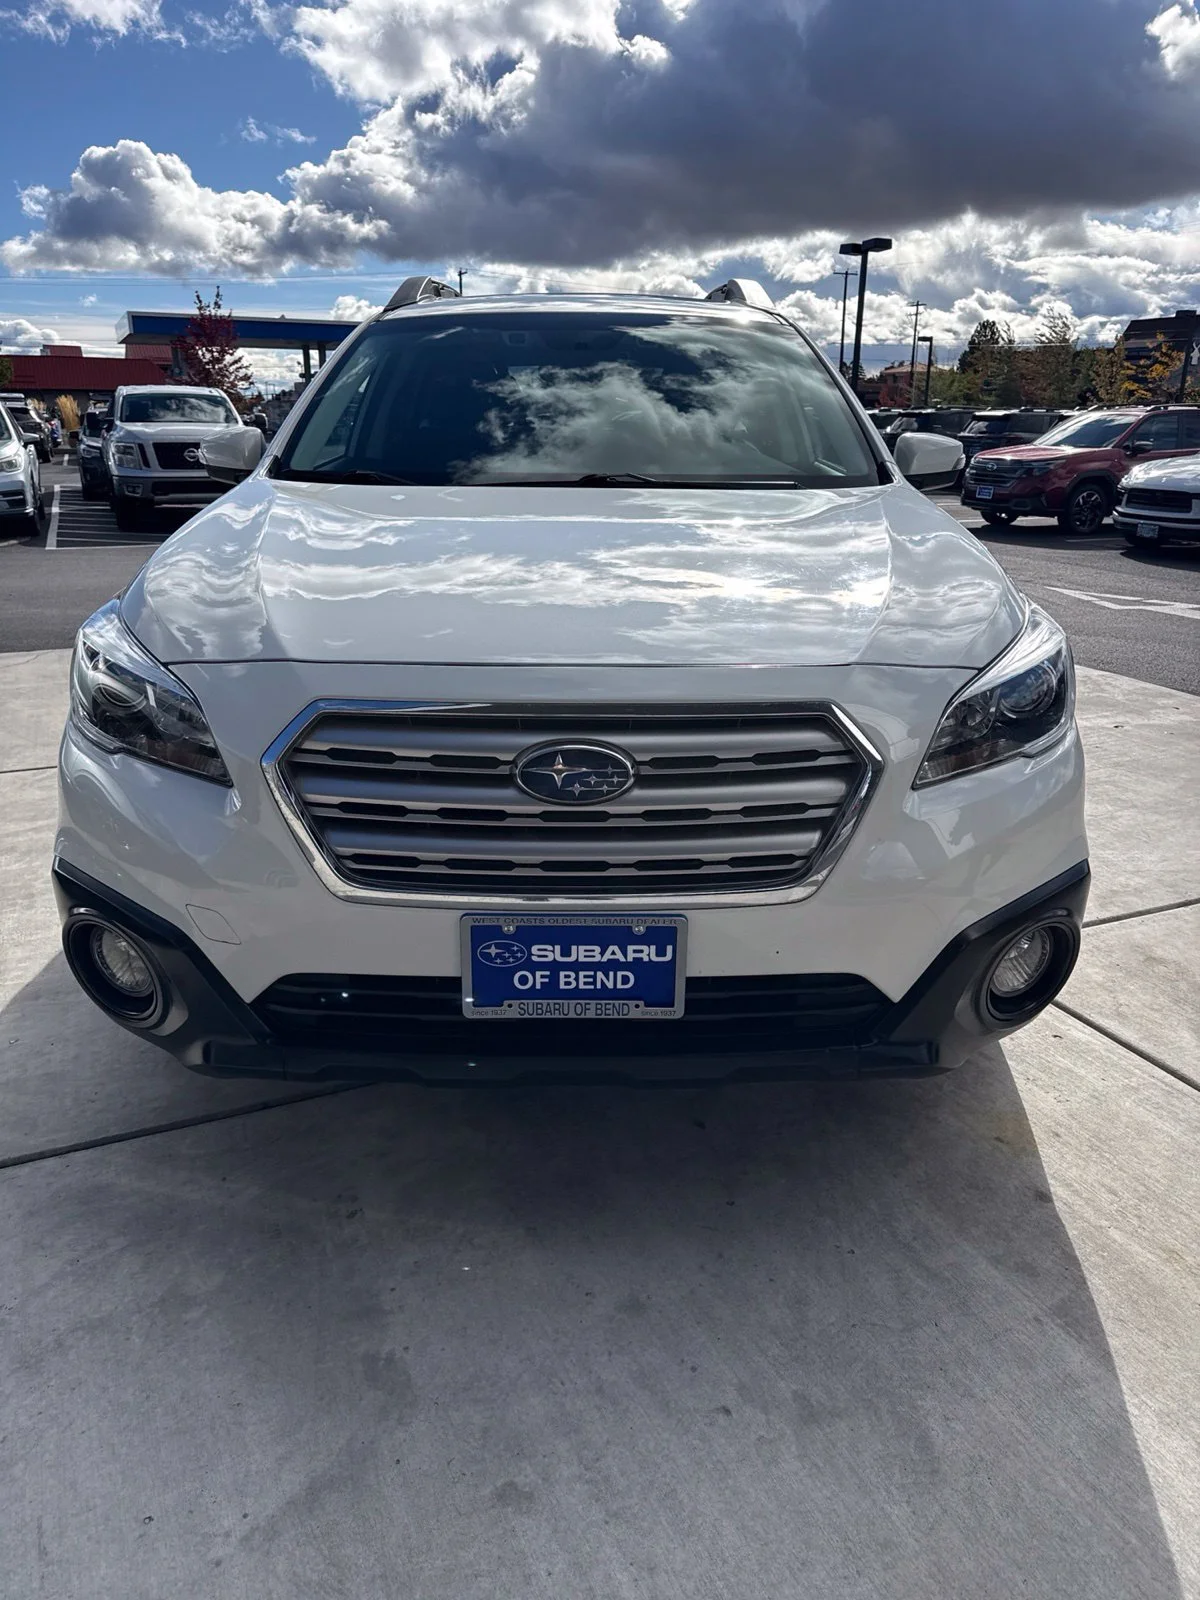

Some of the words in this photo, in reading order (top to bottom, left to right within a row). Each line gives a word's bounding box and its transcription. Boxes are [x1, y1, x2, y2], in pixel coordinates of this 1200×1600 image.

[531, 945, 673, 962] SUBARU
[513, 971, 550, 989] OF
[559, 971, 635, 989] BEND
[518, 1002, 570, 1016] SUBARU
[574, 1002, 591, 1016] OF
[595, 1002, 630, 1016] BEND
